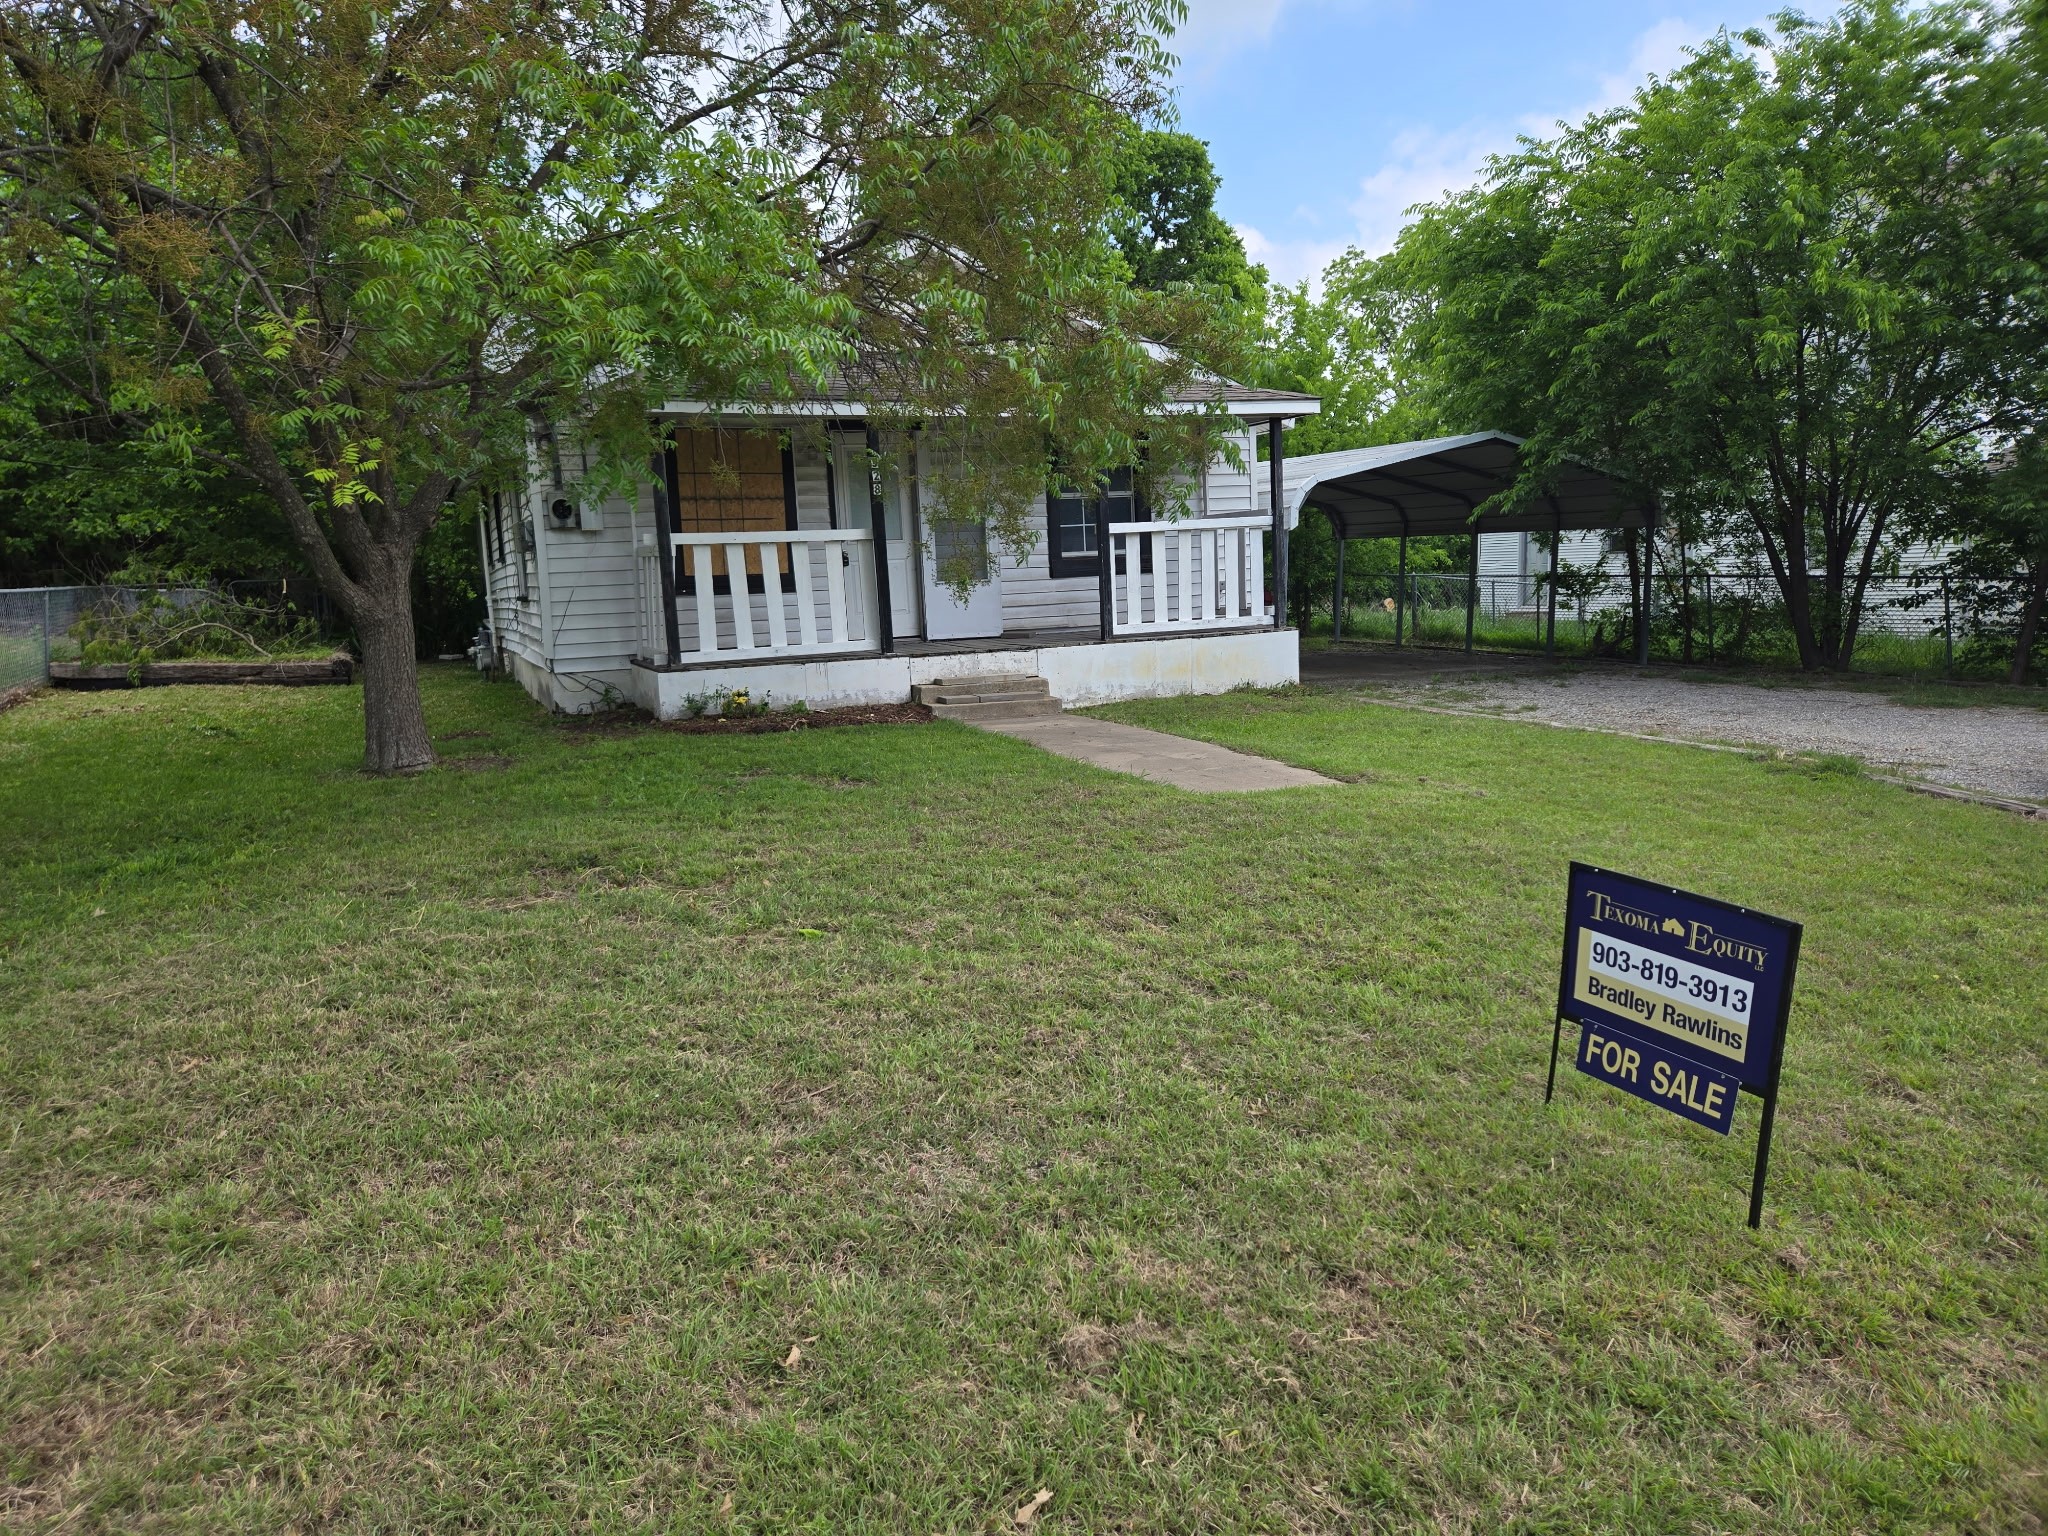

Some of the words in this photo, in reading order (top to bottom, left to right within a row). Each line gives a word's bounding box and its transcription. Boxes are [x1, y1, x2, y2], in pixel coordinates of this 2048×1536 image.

[1586, 890, 1660, 935] TEXOMA
[1684, 920, 1768, 966] EQUITY
[1588, 976, 1656, 1020] Bradley
[1662, 1002, 1743, 1050] Rawlins
[1592, 941, 1748, 1013] 903-819-3913
[1585, 1033, 1641, 1083] FOR
[1650, 1060, 1727, 1119] SALE
